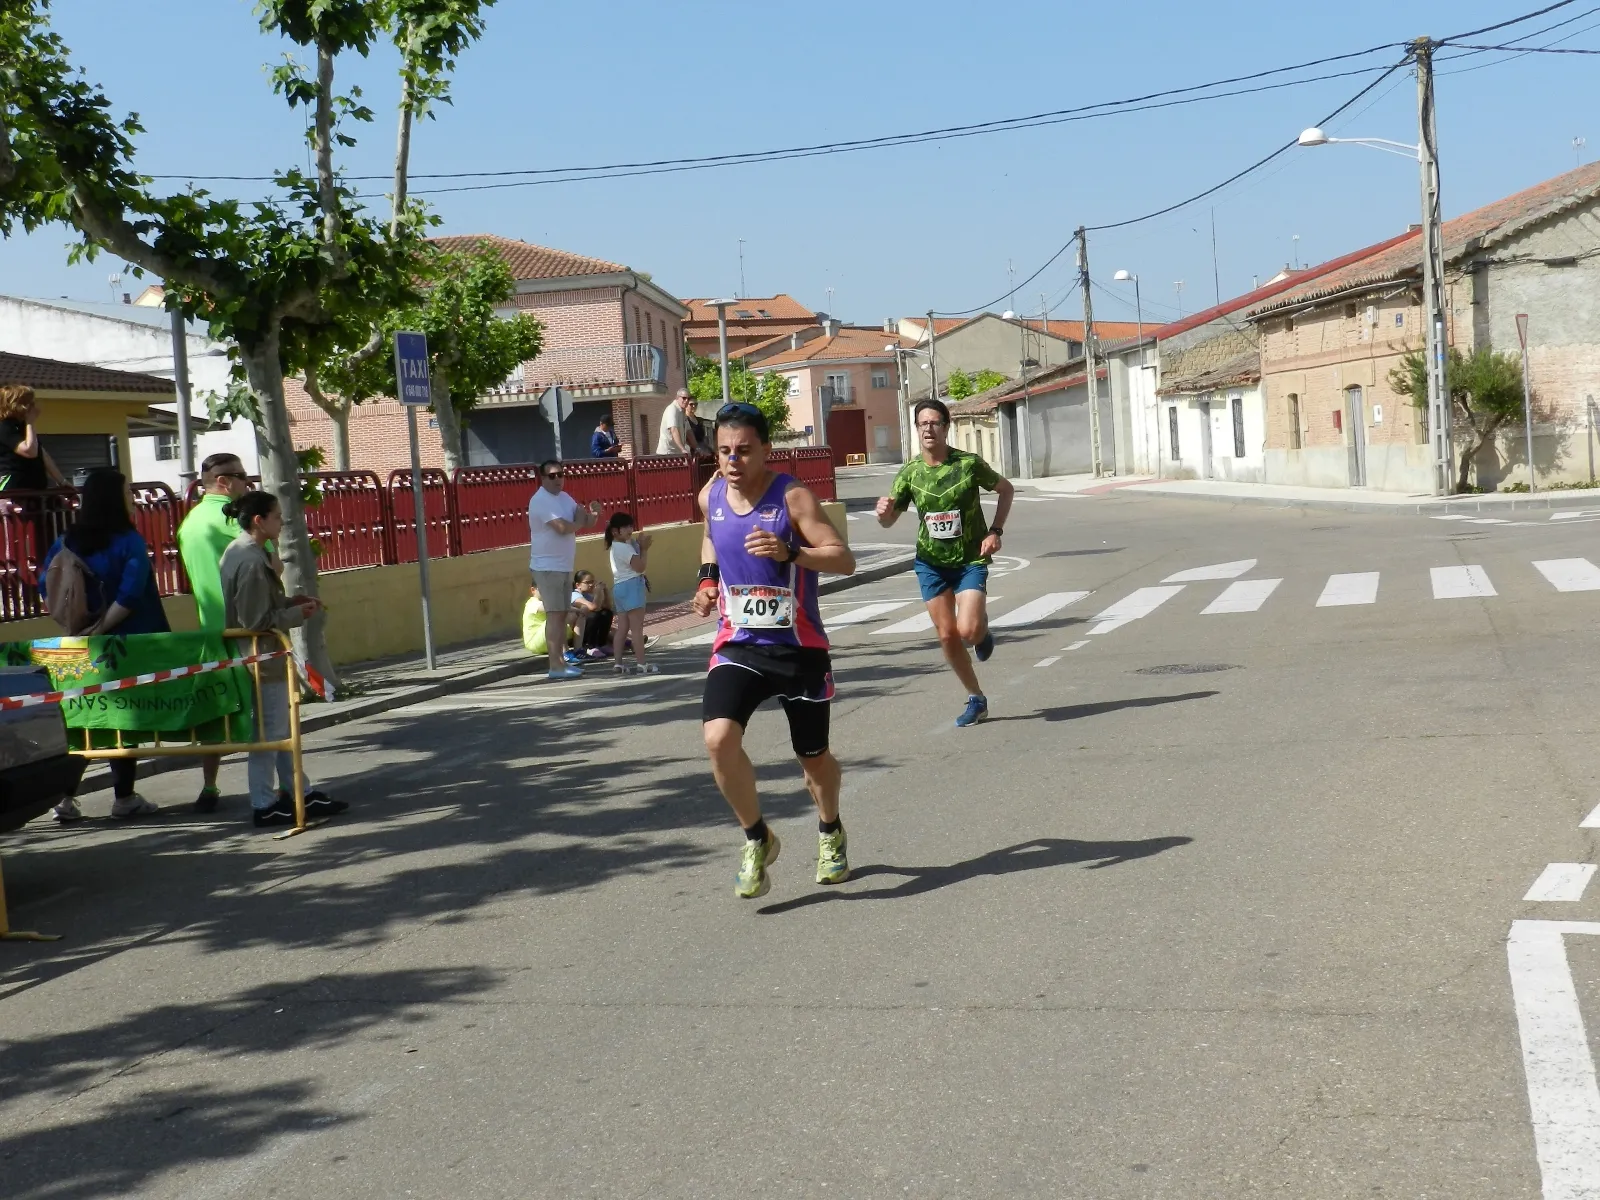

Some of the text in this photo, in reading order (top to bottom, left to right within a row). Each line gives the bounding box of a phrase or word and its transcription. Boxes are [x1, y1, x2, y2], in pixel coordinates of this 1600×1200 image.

[401, 358, 428, 379] TAXI
[932, 520, 953, 532] 337
[743, 598, 780, 616] 409
[69, 695, 108, 711] SAN
